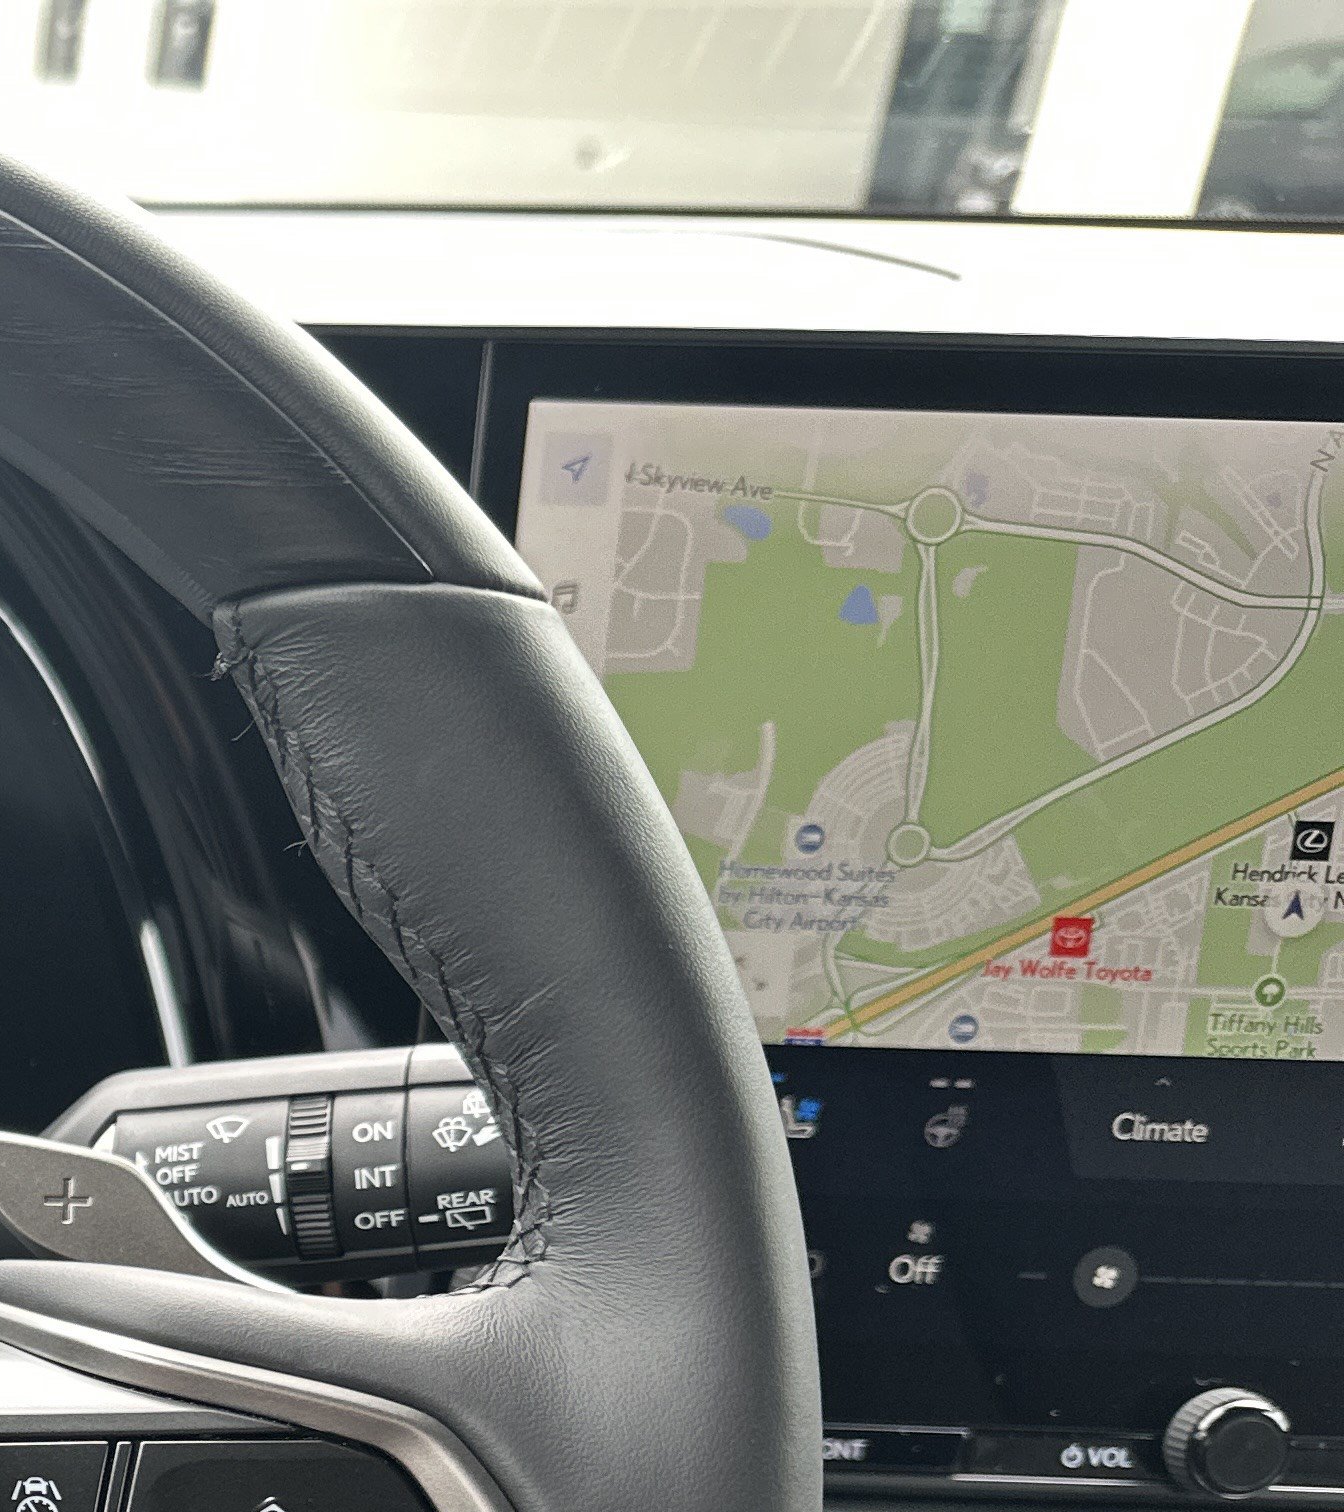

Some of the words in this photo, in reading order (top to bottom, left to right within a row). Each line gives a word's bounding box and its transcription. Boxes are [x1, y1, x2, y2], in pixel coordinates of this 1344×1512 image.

[639, 462, 725, 494] Skyview
[730, 475, 774, 501] Ave
[719, 860, 833, 882] Homewood
[837, 863, 896, 884] Suites
[1231, 862, 1317, 883] Hendrick
[1214, 886, 1271, 907] Kansa
[744, 911, 783, 932] City
[789, 911, 859, 933] Airport
[983, 960, 1012, 982] Jay
[1020, 960, 1077, 980] Wolfe
[1085, 962, 1153, 983] Toyota
[1211, 1014, 1277, 1037] Tiffany
[1283, 1015, 1324, 1036] Hills
[1208, 1040, 1268, 1058] Sports
[1275, 1040, 1317, 1059] Park
[352, 1121, 394, 1143] ON
[1113, 1112, 1210, 1144] Climate
[155, 1142, 204, 1164] MIST
[156, 1162, 200, 1186] OFF
[354, 1163, 399, 1190] INT
[226, 1190, 269, 1208] AUTO
[436, 1188, 495, 1210] REAR
[354, 1207, 409, 1230] OFF
[889, 1255, 945, 1284] Off
[1088, 1447, 1135, 1470] VOL
